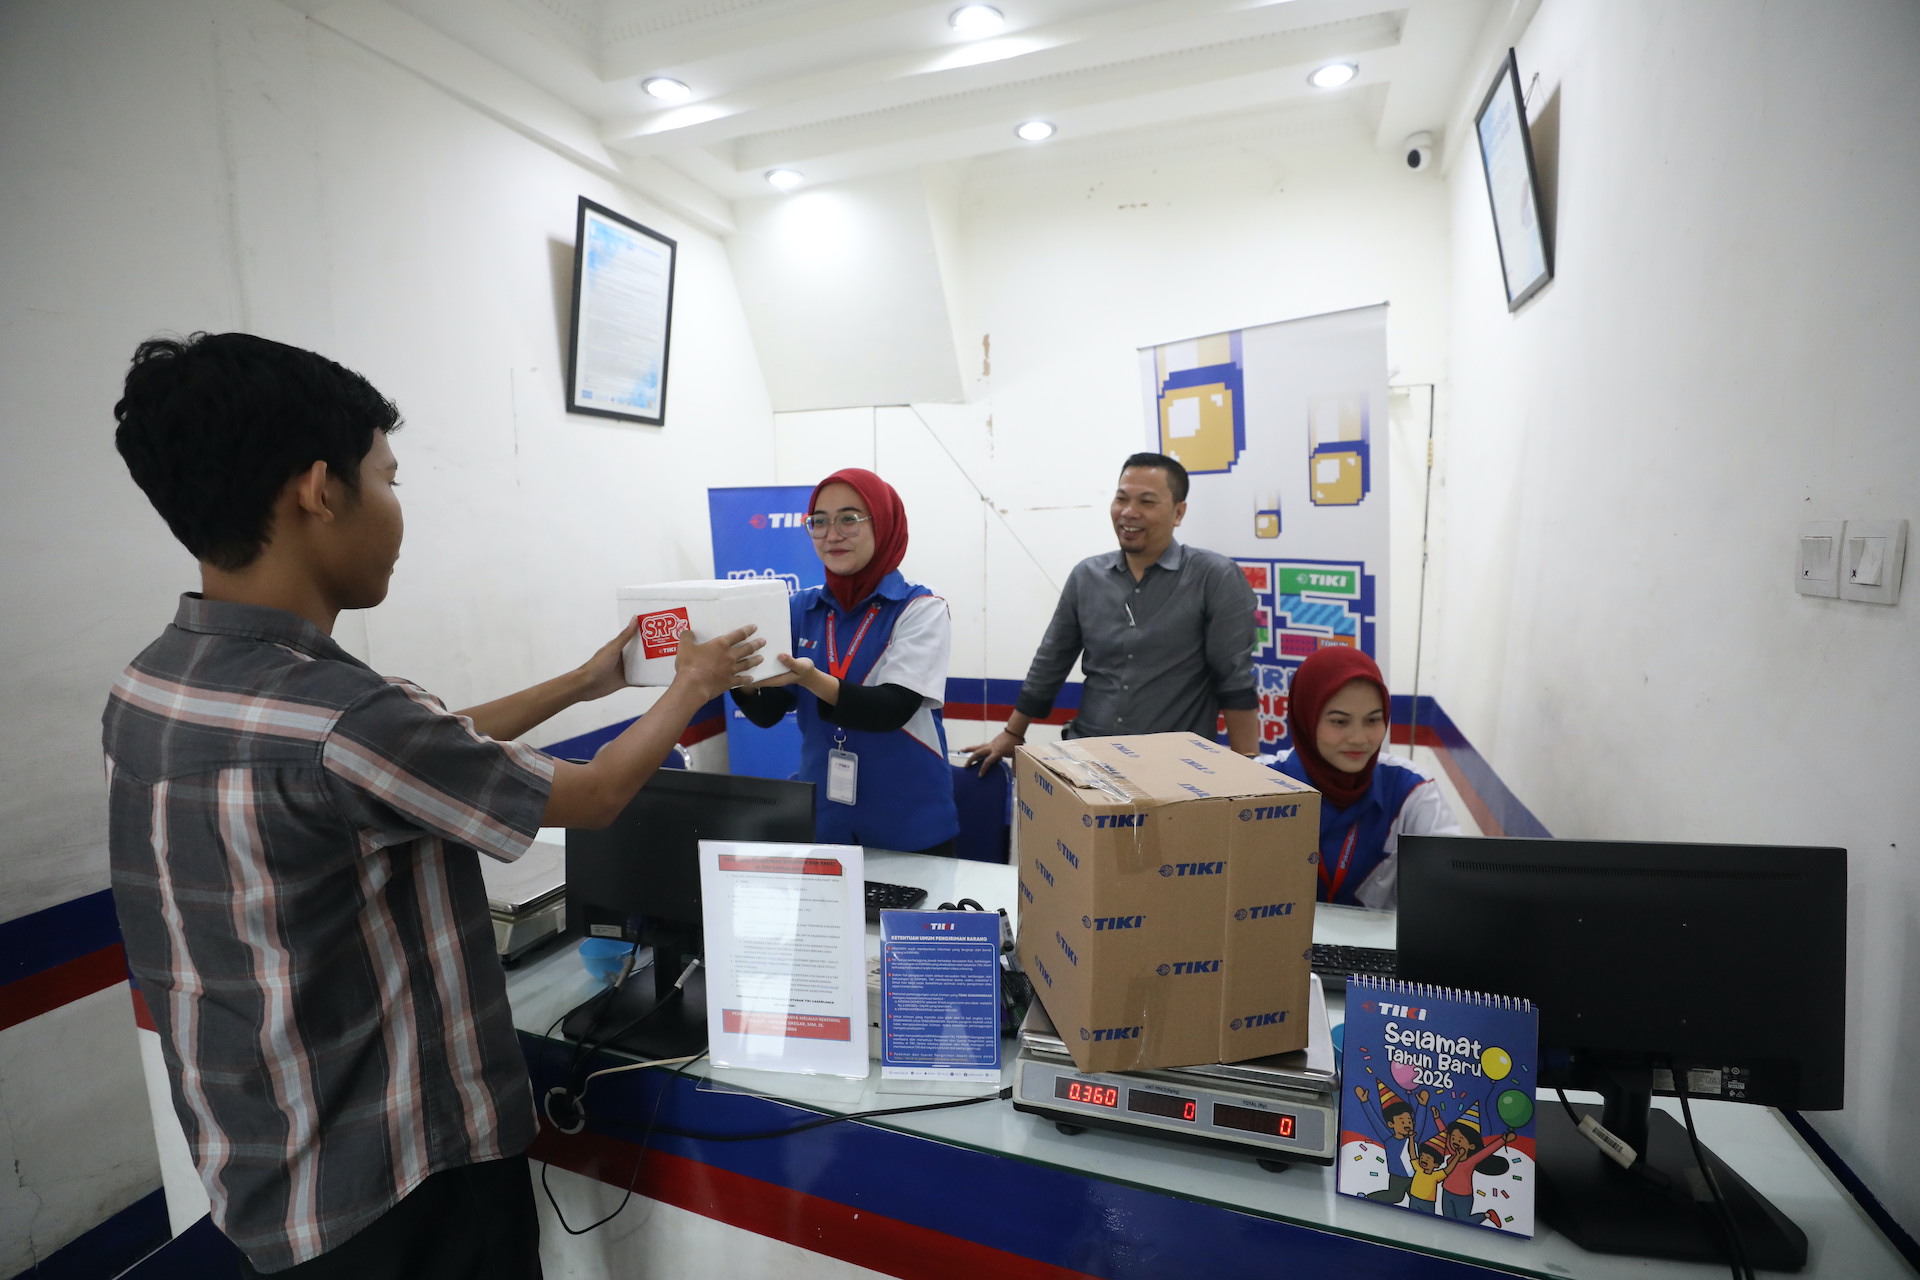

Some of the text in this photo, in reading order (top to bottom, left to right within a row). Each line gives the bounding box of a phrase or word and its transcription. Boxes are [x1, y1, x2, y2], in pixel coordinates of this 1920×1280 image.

[768, 512, 809, 528] TIK
[1309, 574, 1347, 587] TIKI
[644, 616, 677, 639] SRP
[1039, 774, 1053, 796] TIKI
[1020, 800, 1034, 820] TIKI
[1254, 804, 1298, 821] TIKI
[1094, 814, 1144, 829] TIKI
[1062, 842, 1078, 870] TIKI
[1040, 862, 1054, 888] TIKI
[1176, 862, 1223, 877] TIKI
[1020, 880, 1034, 904] TIKI
[1249, 902, 1292, 920] TIKI
[1094, 916, 1142, 931] TIKI
[1061, 936, 1077, 967] TIKI
[1039, 960, 1052, 988] TIKI
[1172, 959, 1219, 976] TIKI
[1244, 1011, 1286, 1028] TIKI
[1378, 1002, 1427, 1021] TIKI
[1092, 1026, 1138, 1042] TIKI
[1384, 1022, 1482, 1060] Selamat
[1384, 1045, 1482, 1078] Tahun Baru
[1413, 1068, 1454, 1089] 2026
[1069, 1083, 1116, 1106] 0.360
[1184, 1102, 1195, 1119] 0
[1280, 1118, 1292, 1136] 0
